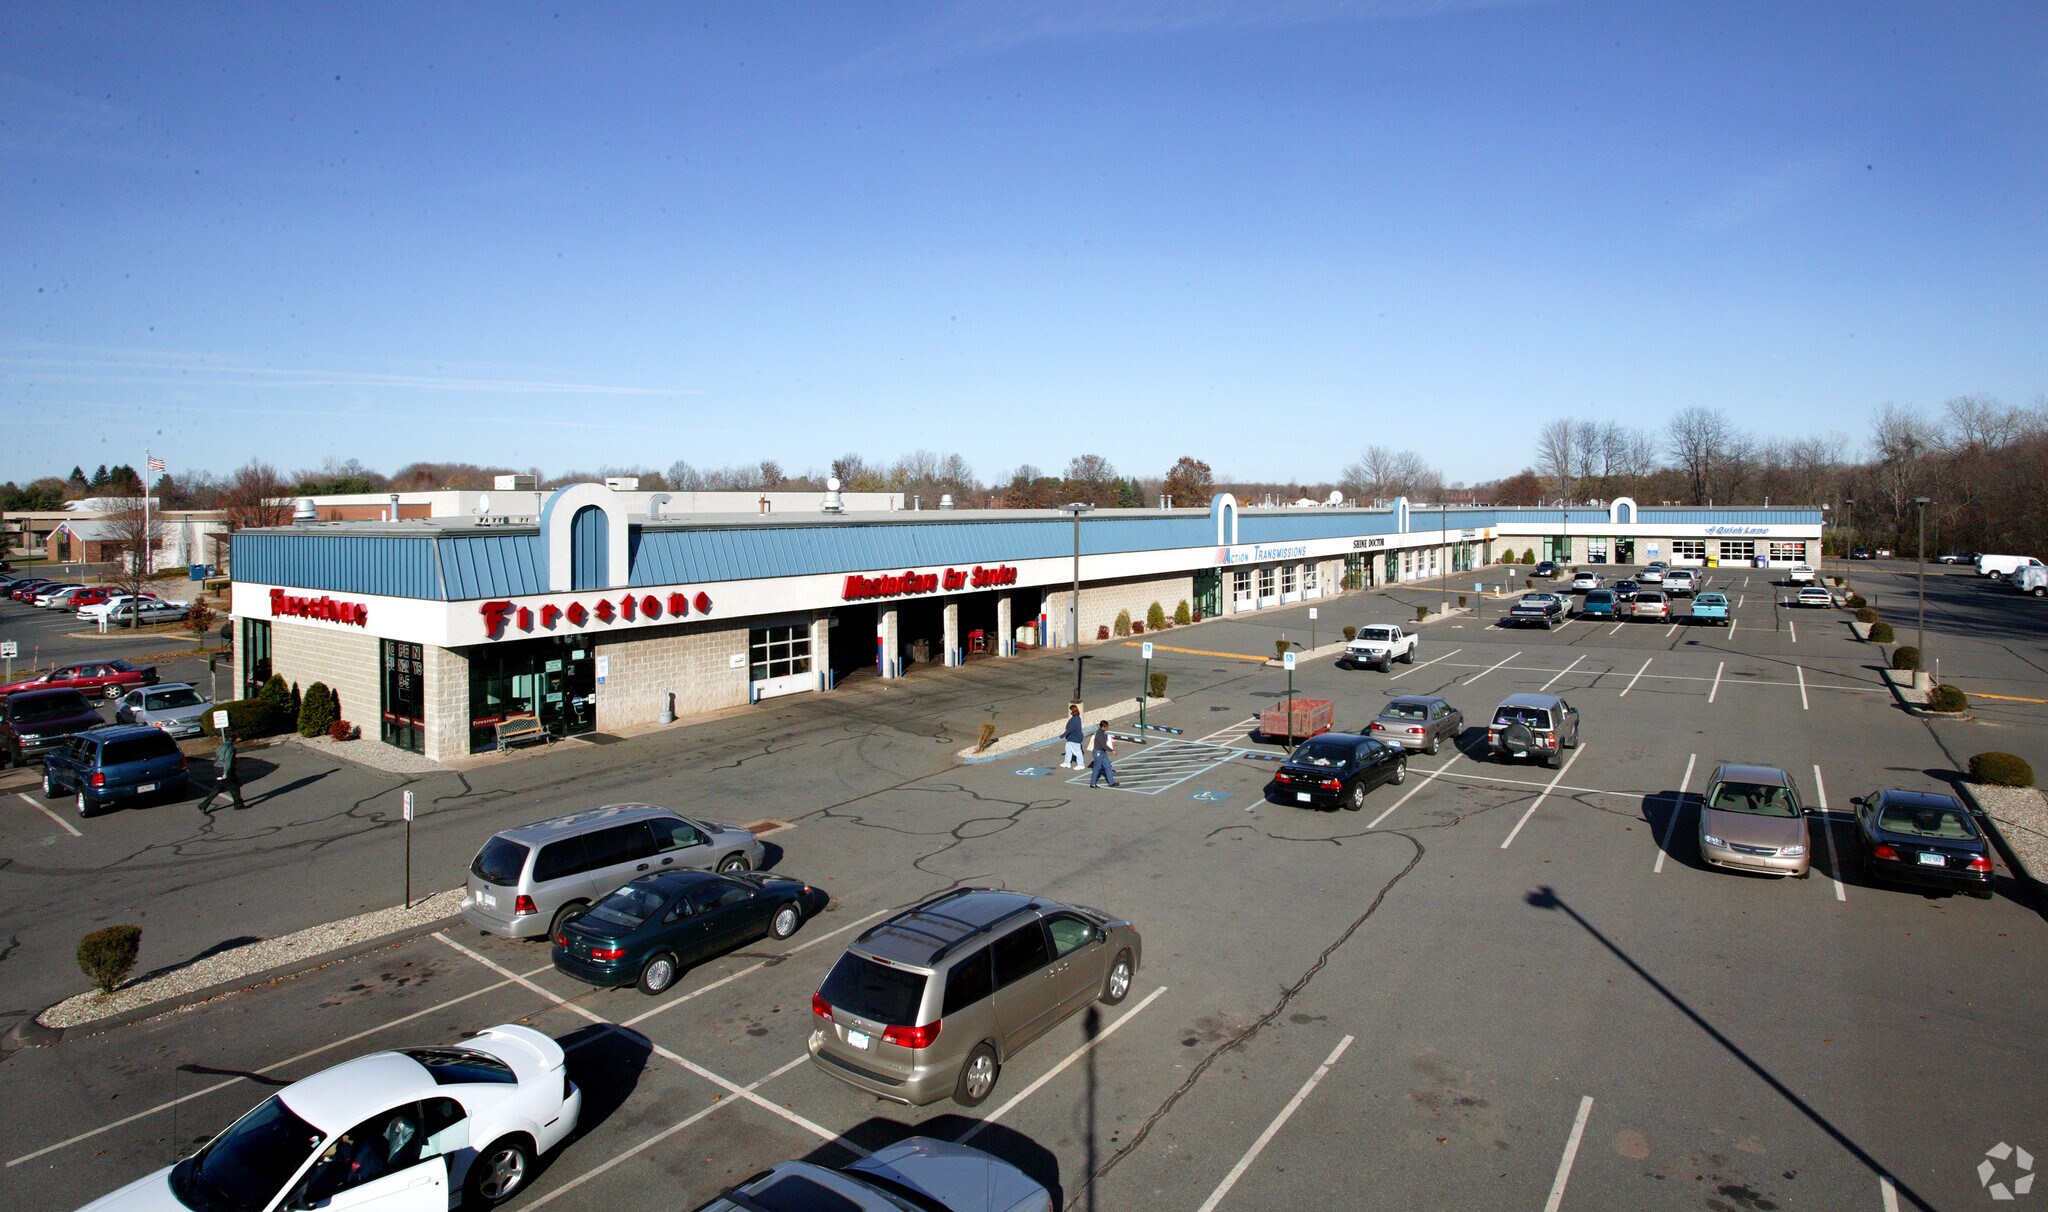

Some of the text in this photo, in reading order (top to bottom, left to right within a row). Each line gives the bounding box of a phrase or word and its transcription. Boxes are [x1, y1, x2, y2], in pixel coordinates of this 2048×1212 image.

[1716, 526, 1769, 535] Quick Lane
[1353, 538, 1385, 549] SHINE DOCTOR
[1223, 545, 1307, 564] ACTION TRANSMISSIONS
[841, 564, 1017, 600] MasterCare Car Service
[270, 589, 368, 628] Firestone
[479, 591, 711, 638] Firestone
[389, 643, 421, 660] OPEN
[472, 717, 499, 726] Firestone
